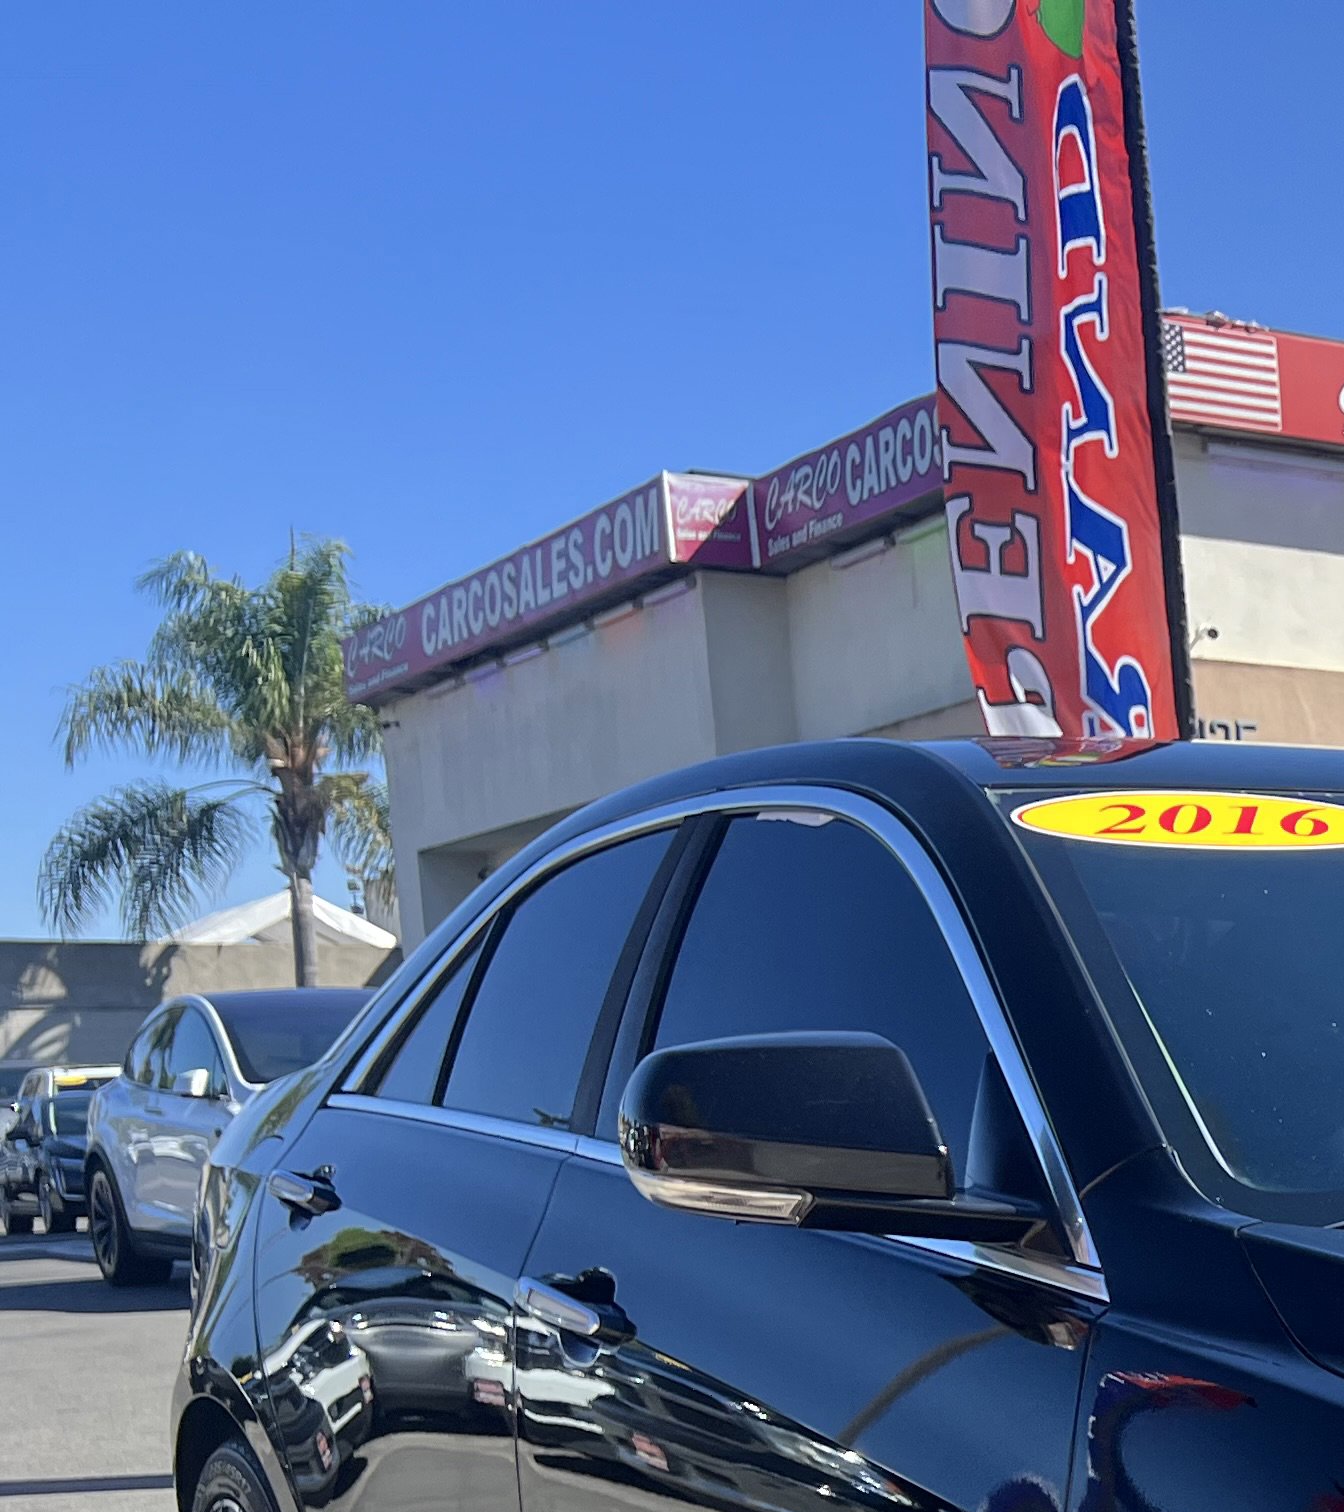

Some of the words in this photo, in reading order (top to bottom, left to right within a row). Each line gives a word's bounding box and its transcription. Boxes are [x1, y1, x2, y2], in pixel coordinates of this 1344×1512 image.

[764, 449, 841, 531] CARCO
[421, 487, 660, 656] CARCOSALES.COM
[1099, 803, 1330, 837] 2016
